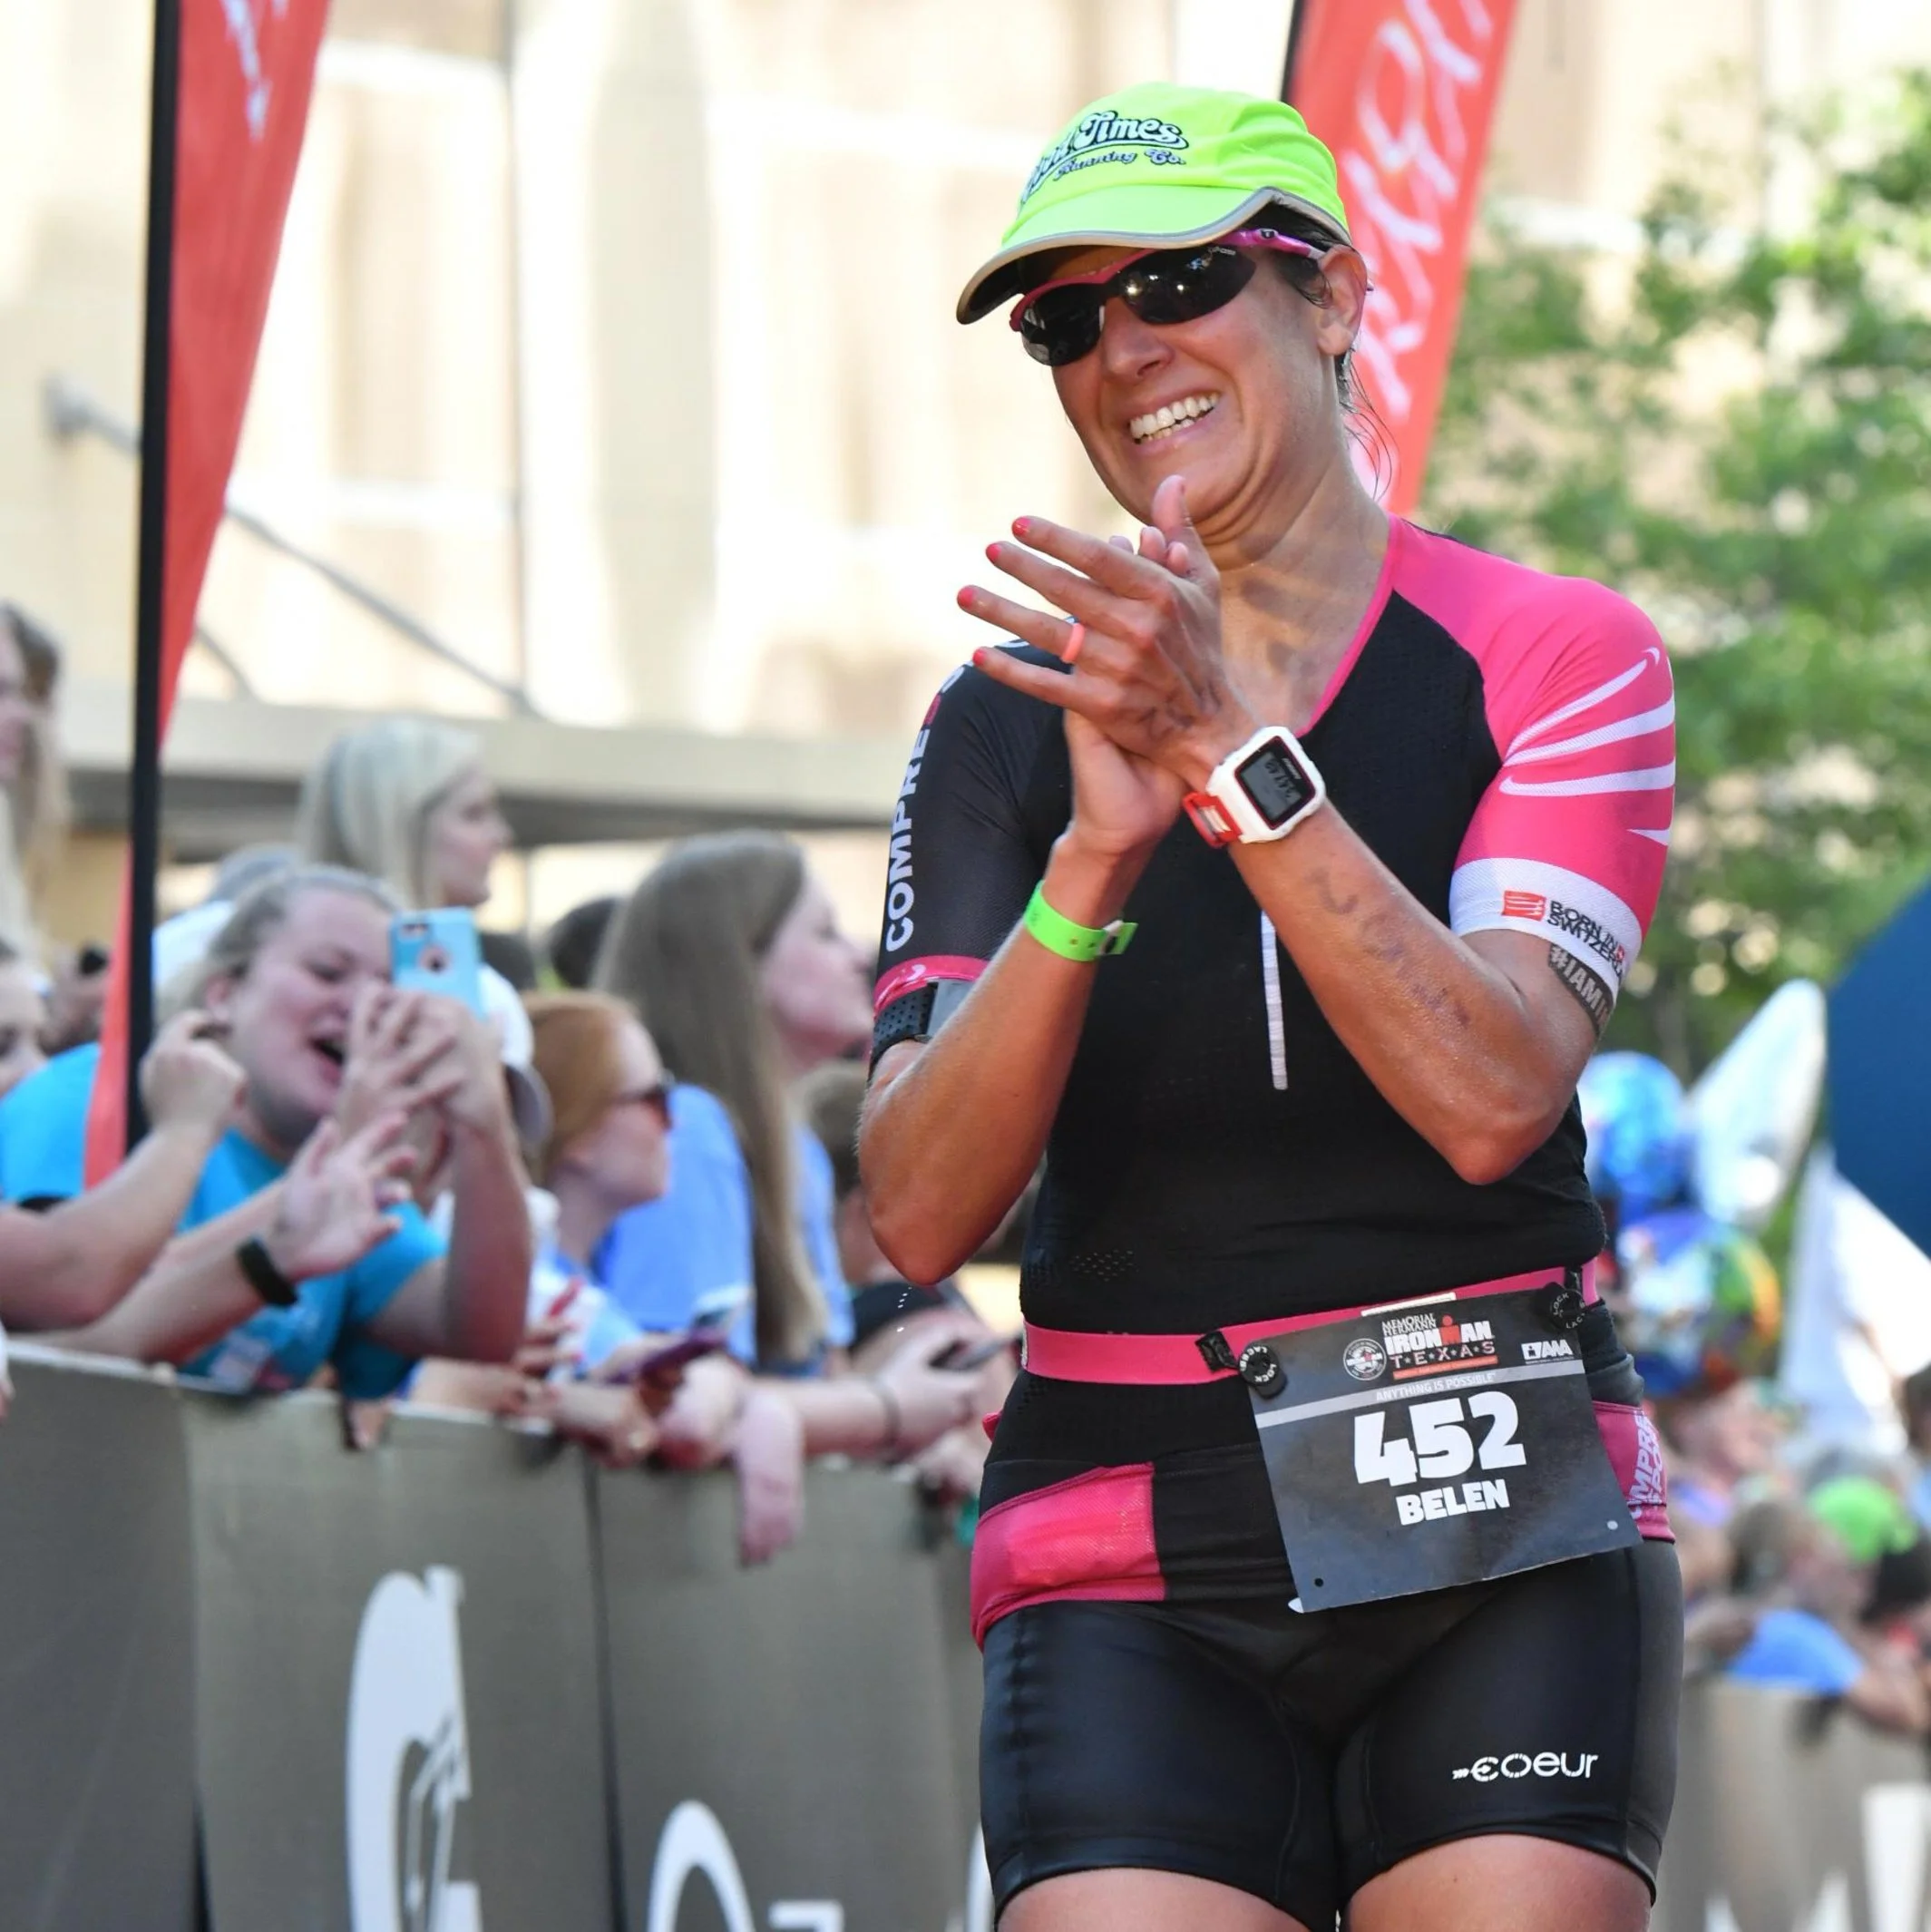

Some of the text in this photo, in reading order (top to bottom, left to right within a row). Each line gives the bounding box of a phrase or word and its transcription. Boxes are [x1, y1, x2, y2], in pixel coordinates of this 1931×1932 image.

[1074, 110, 1189, 150] Times
[1549, 900, 1619, 955] BORN IN
[1381, 1312, 1436, 1330] MEMORIAL
[1383, 1320, 1437, 1336] HERMANN
[1384, 1314, 1494, 1355] IRONMAN
[1376, 1381, 1432, 1401] ANYTHING
[1434, 1379, 1445, 1390] IS
[1354, 1390, 1526, 1487] 452
[1396, 1478, 1510, 1526] BELEN
[1470, 1751, 1599, 1782] coeur
